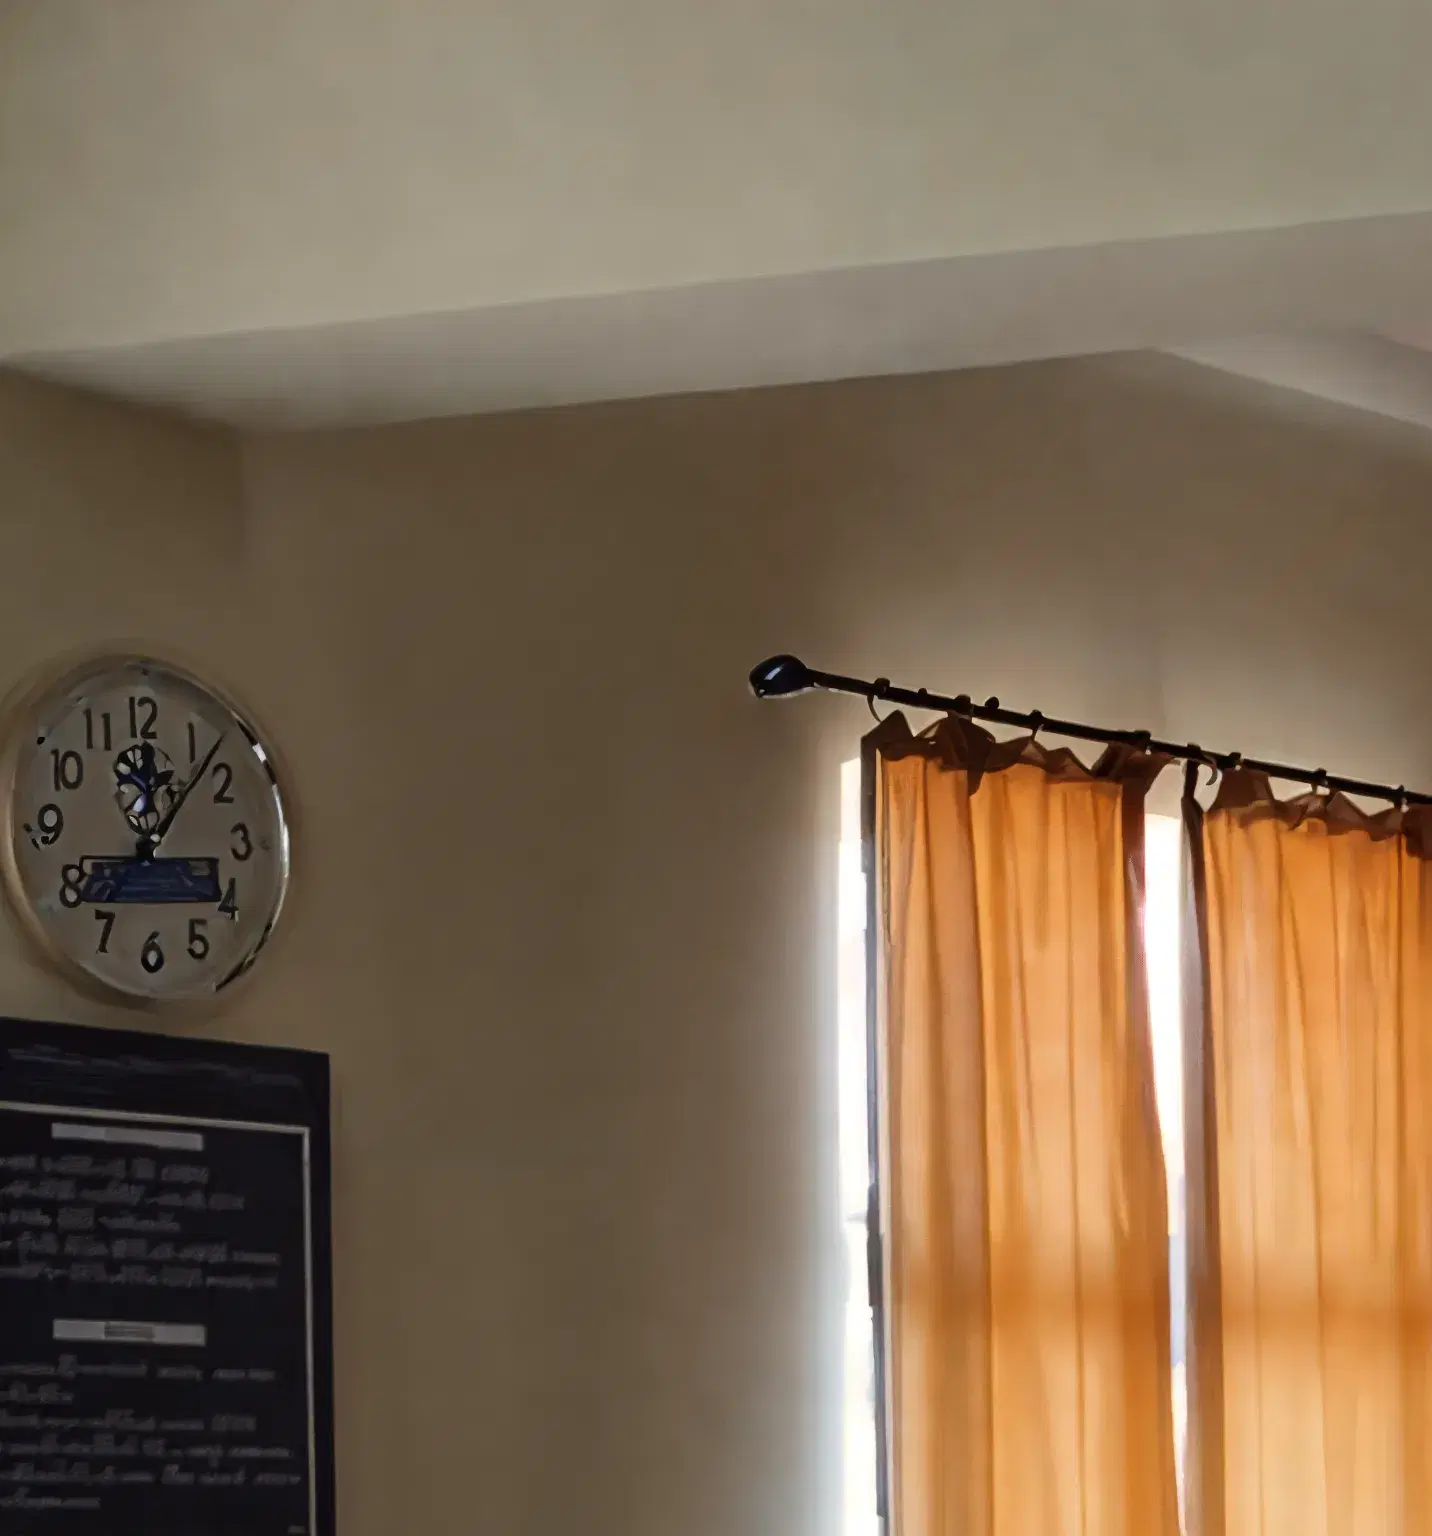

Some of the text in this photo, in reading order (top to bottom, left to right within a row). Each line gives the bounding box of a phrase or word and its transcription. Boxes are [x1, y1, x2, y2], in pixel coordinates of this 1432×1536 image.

[84, 708, 112, 751] 11
[129, 696, 158, 739] 12
[187, 722, 196, 762] 1
[51, 749, 83, 791] 10
[212, 763, 235, 804] 2
[37, 804, 64, 845] 9
[230, 823, 254, 860] 3
[59, 864, 84, 908] 8
[218, 877, 239, 920] 4
[95, 910, 116, 953] 7
[141, 930, 165, 973] 6
[187, 919, 210, 959] 5
